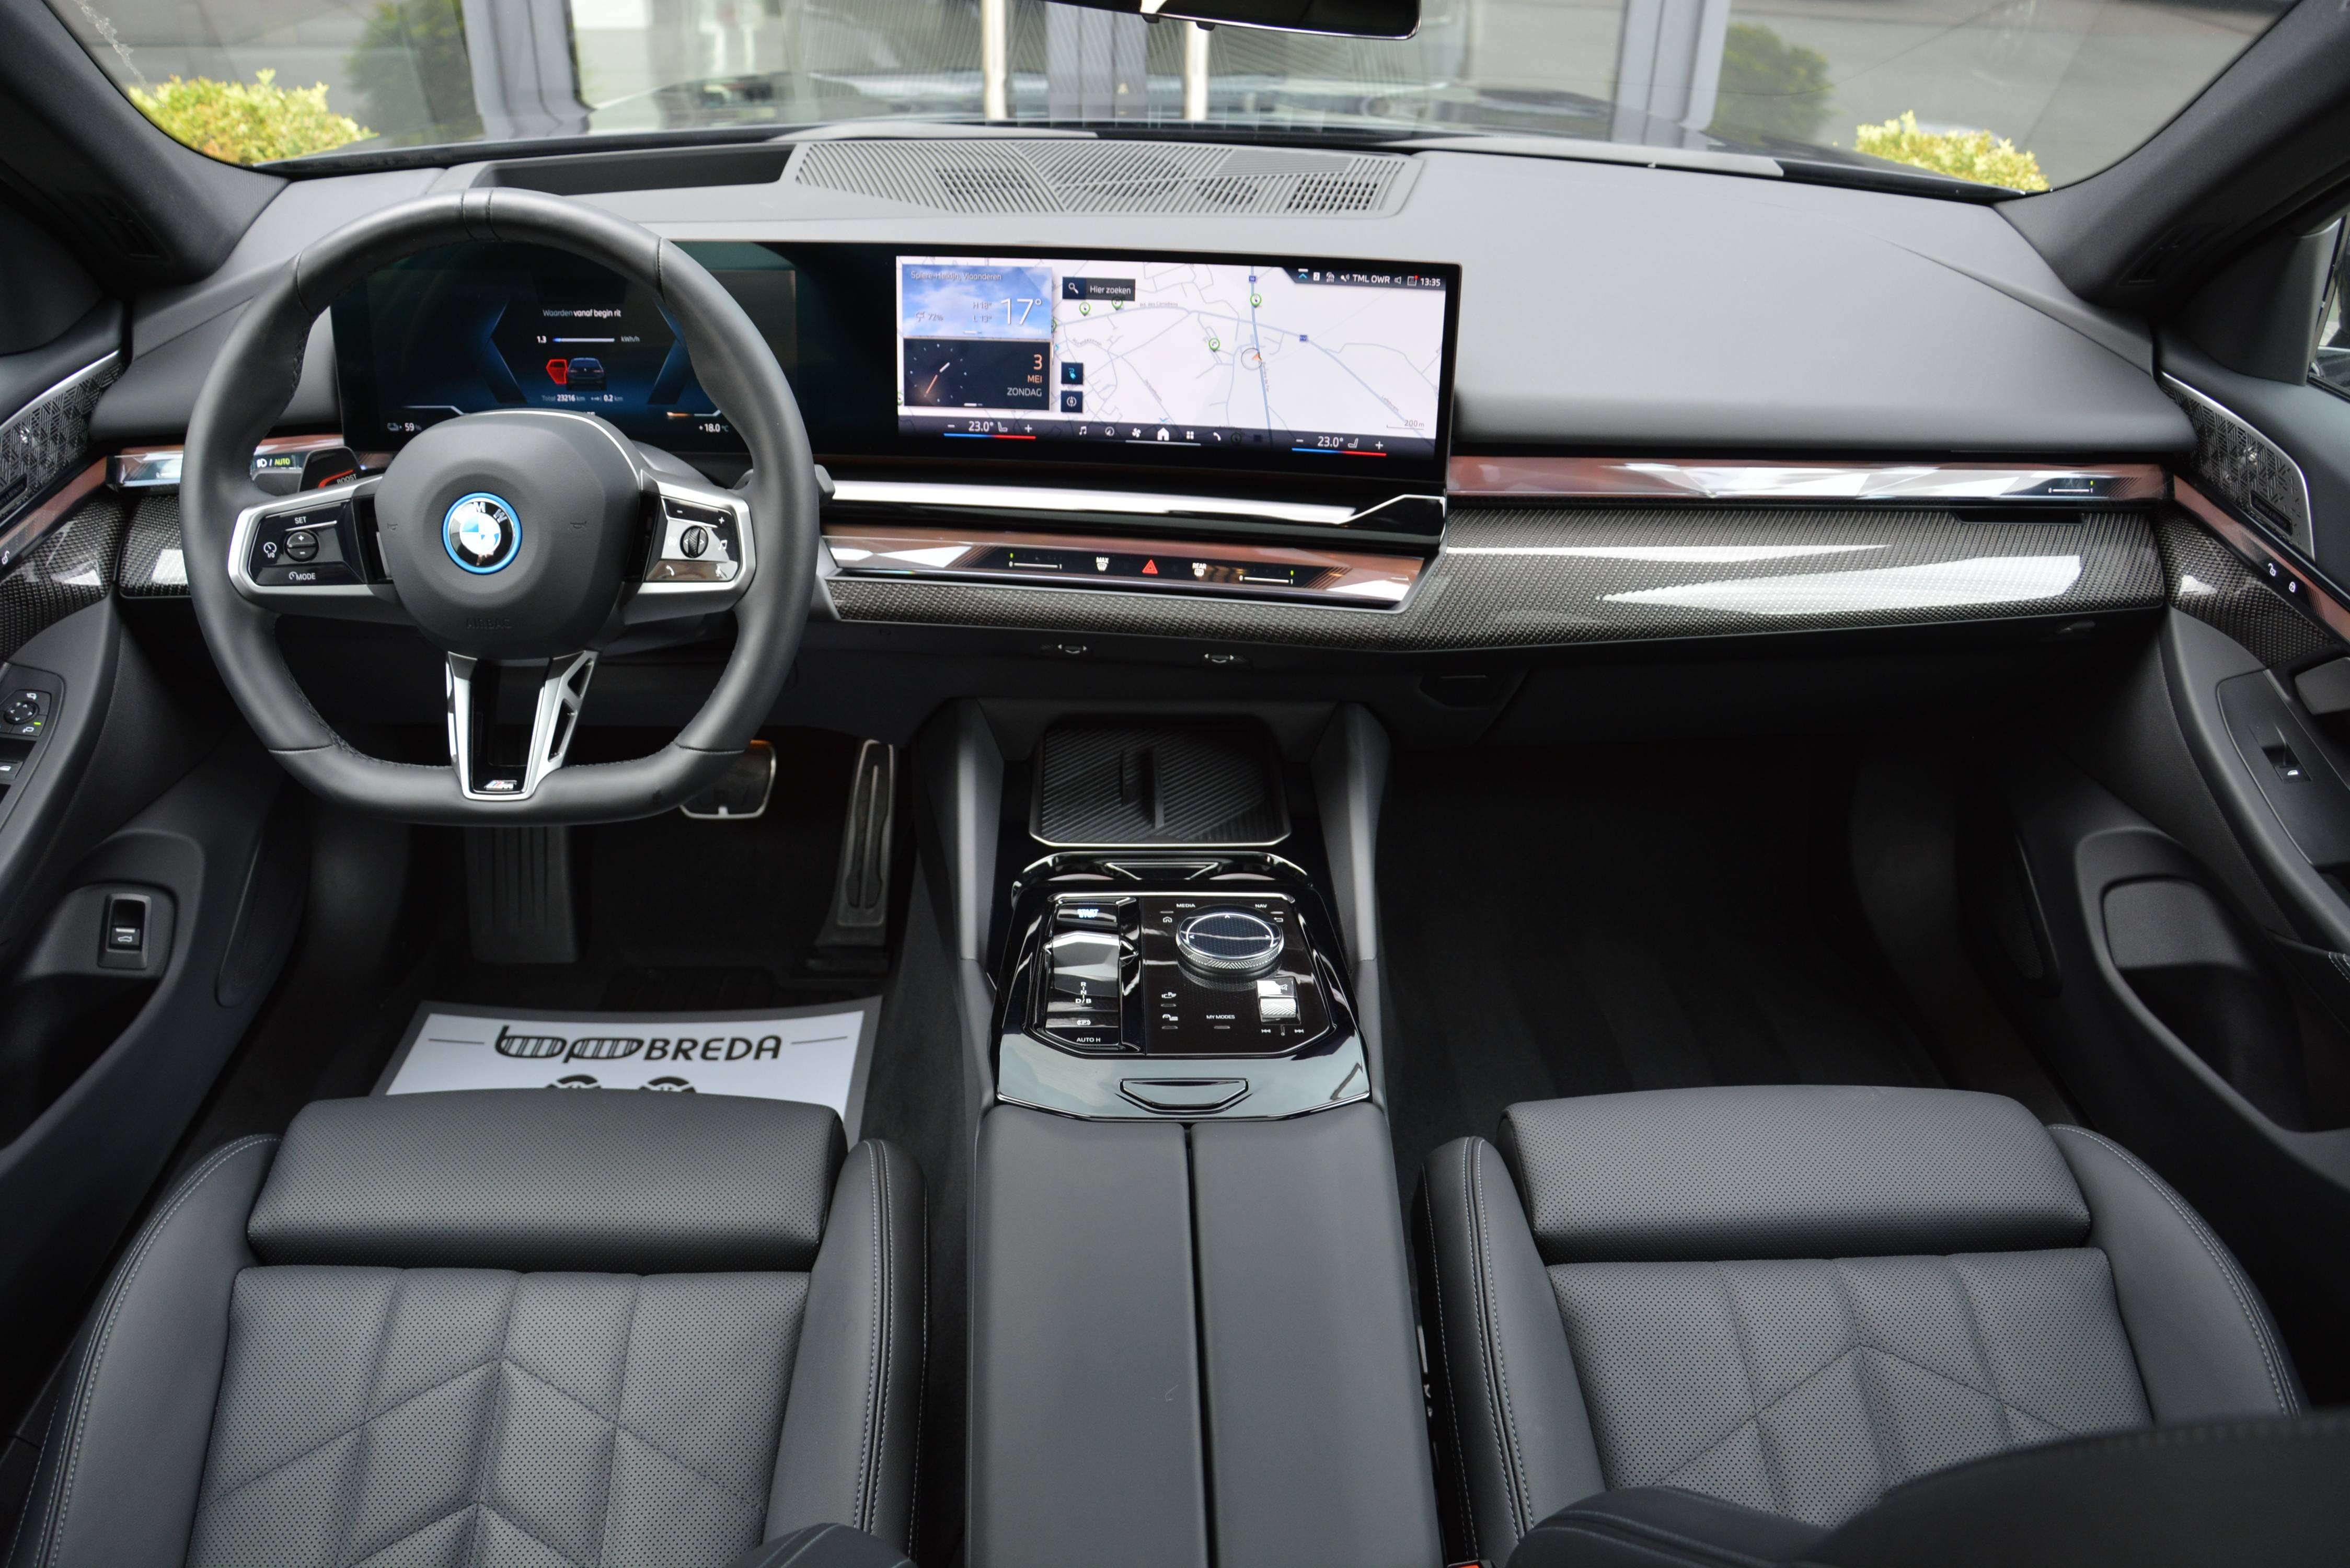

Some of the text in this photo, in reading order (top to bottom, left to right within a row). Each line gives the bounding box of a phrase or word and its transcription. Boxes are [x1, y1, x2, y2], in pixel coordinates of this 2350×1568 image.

[963, 272, 1001, 281] Vlaanderen
[1352, 274, 1390, 284] TML OWR
[1420, 278, 1441, 286] 13:35
[1090, 285, 1104, 294] Hier
[594, 309, 613, 318] begin
[1033, 354, 1042, 370] 3
[1027, 374, 1042, 383] MEI
[1007, 387, 1042, 397] ZONDAG
[405, 422, 414, 432] 59
[337, 474, 357, 484] BOOST
[294, 516, 307, 524] SET
[296, 572, 316, 581] MODE
[643, 1035, 783, 1061] BREDA
